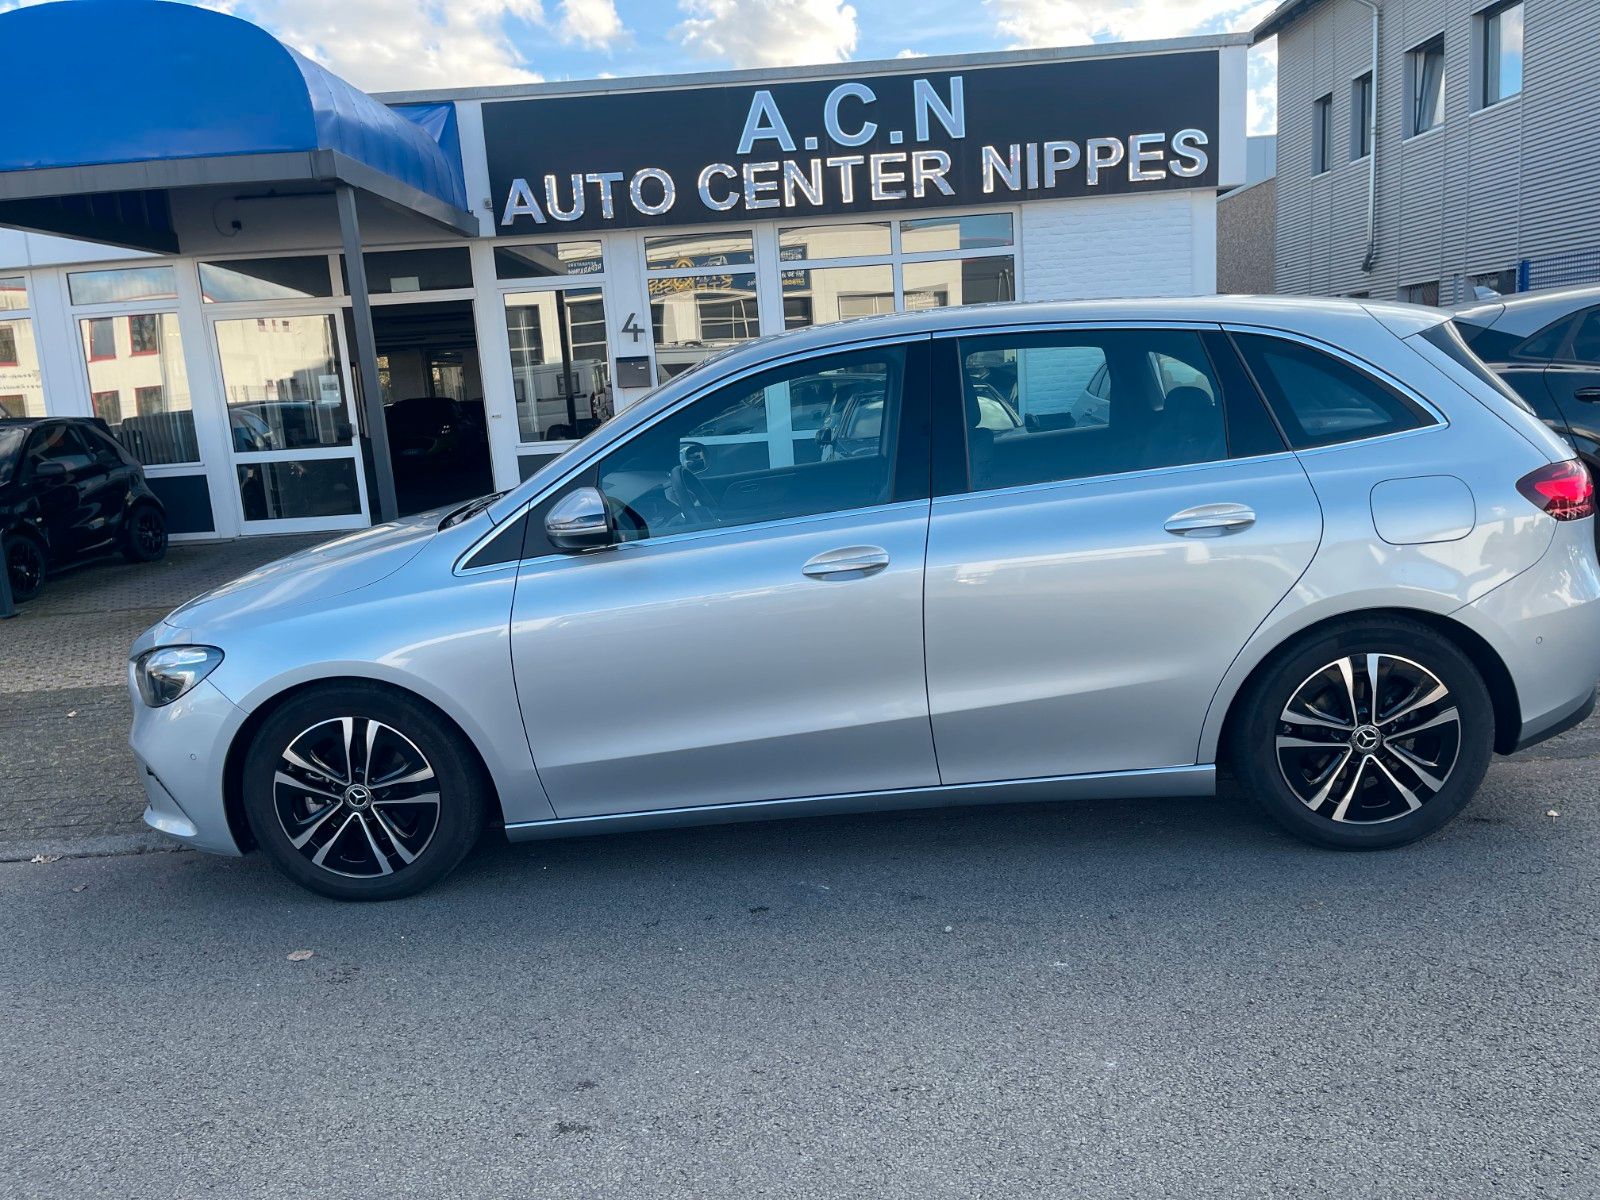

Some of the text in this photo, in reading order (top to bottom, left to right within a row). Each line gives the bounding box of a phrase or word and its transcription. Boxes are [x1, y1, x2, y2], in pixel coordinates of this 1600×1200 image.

[736, 76, 966, 154] A.C.N
[501, 128, 1209, 226] AUTO CENTER NIPPES
[621, 312, 646, 342] 4
